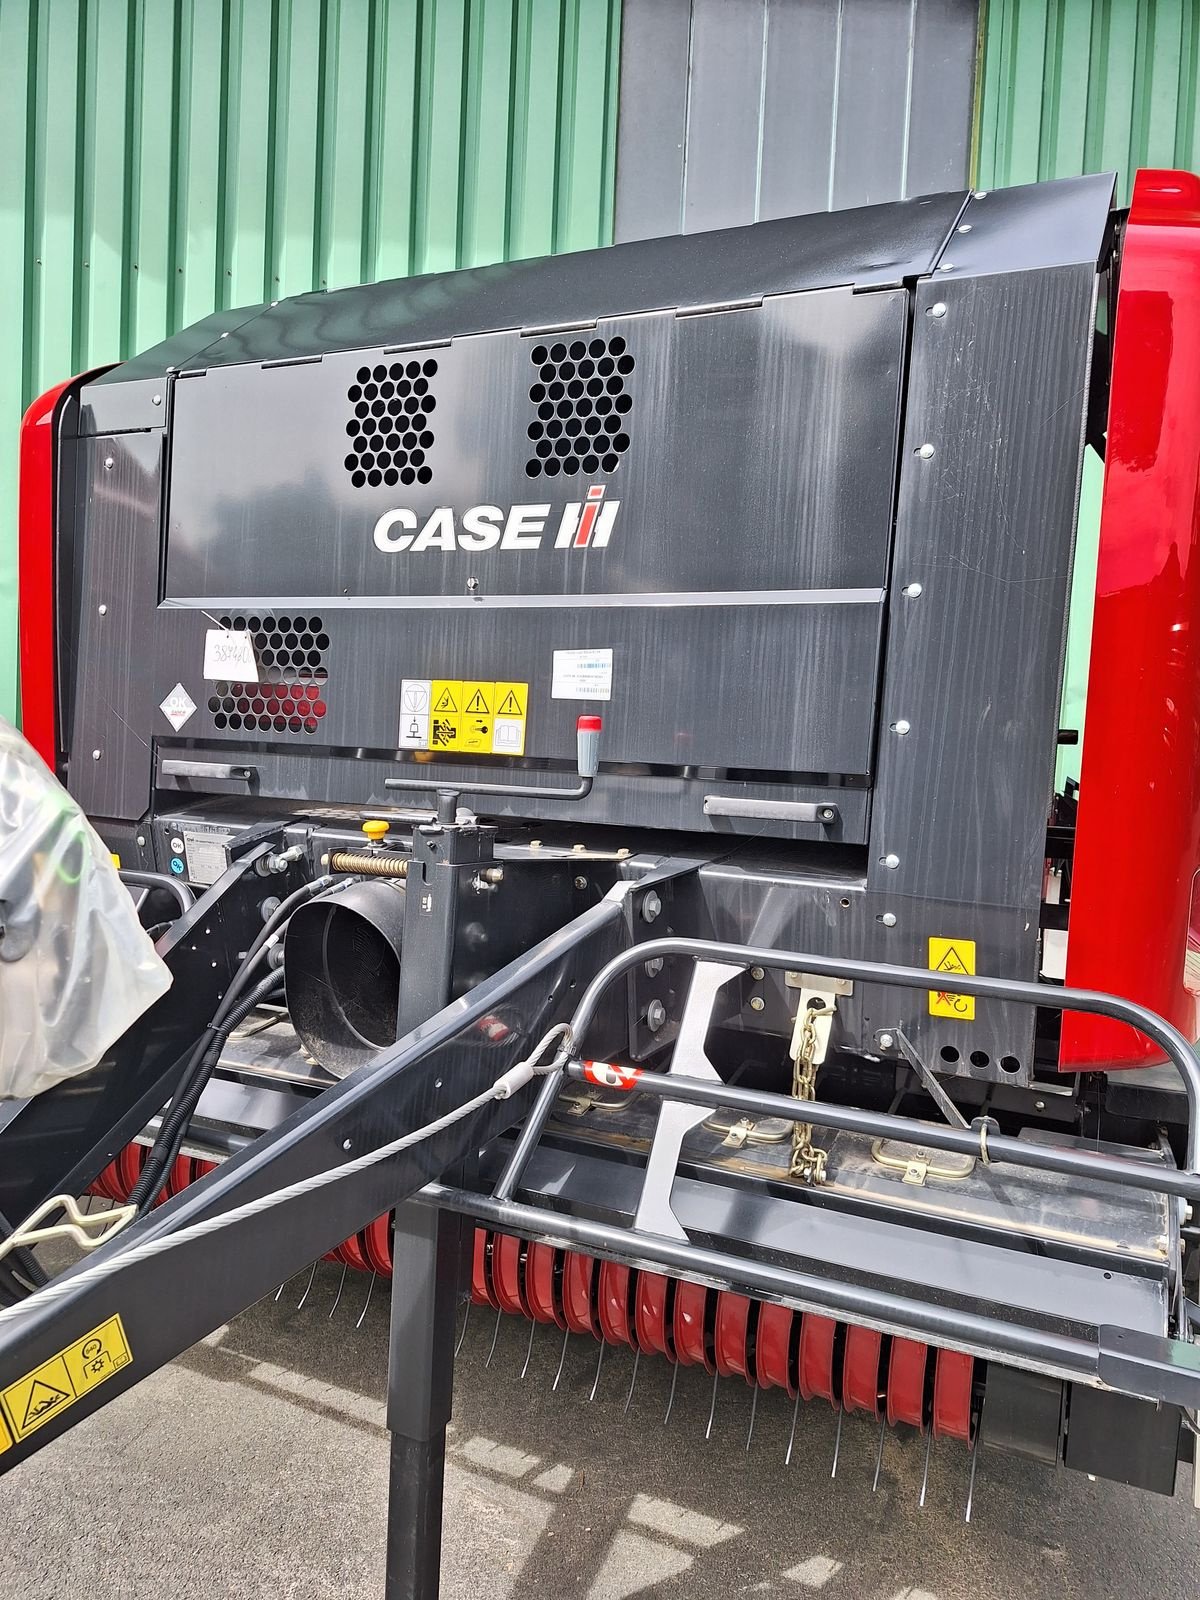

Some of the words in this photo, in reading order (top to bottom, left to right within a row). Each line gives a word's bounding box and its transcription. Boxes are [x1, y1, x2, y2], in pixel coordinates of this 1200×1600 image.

[373, 504, 551, 553] CASE
[170, 697, 188, 708] OK
[172, 860, 183, 872] OK
